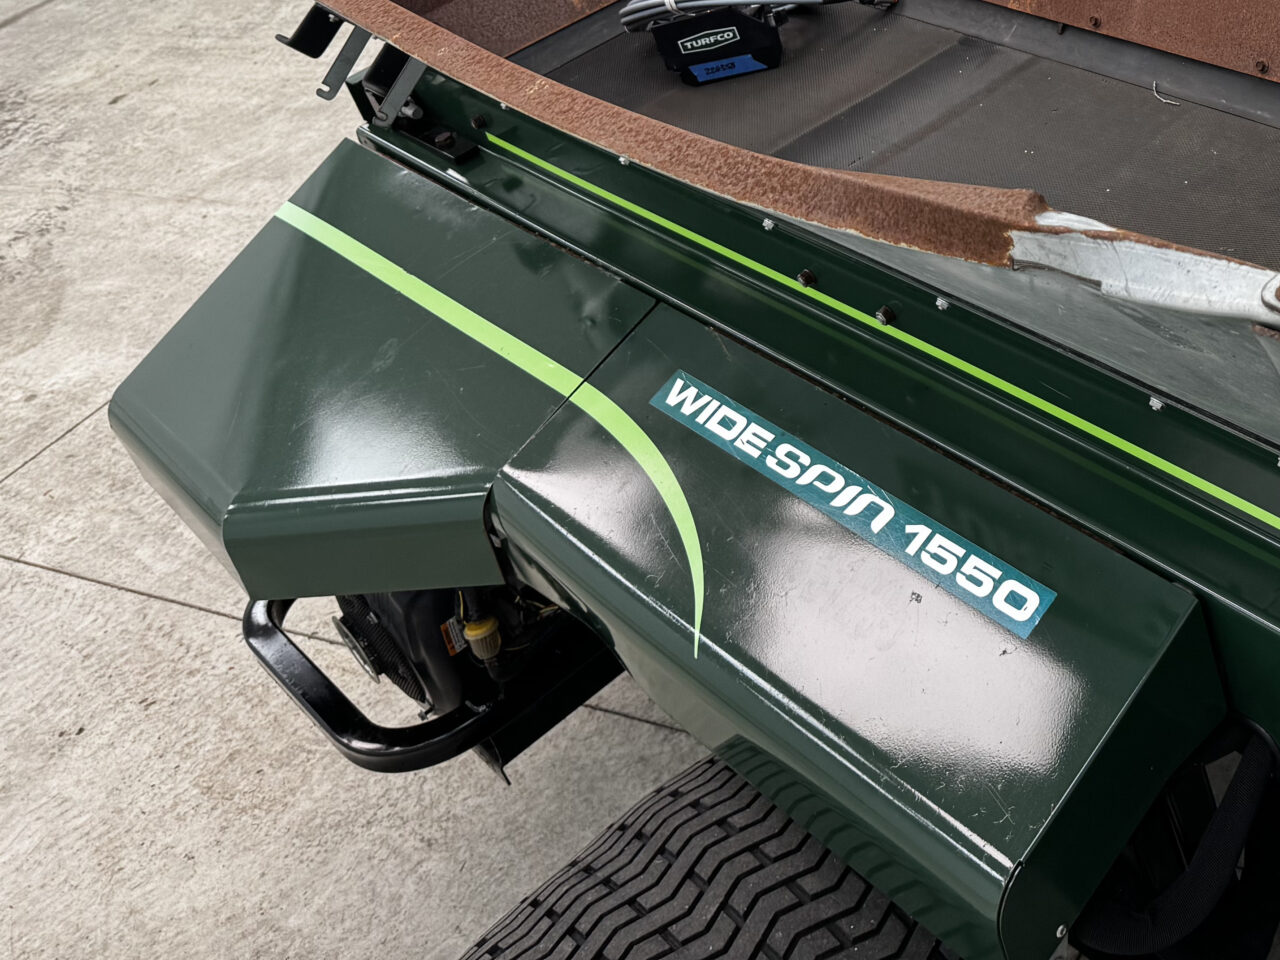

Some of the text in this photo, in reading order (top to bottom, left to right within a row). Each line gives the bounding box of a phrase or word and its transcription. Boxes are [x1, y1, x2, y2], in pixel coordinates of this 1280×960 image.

[684, 32, 734, 49] TURFCO
[664, 378, 1040, 623] WIDESPIN 1550
